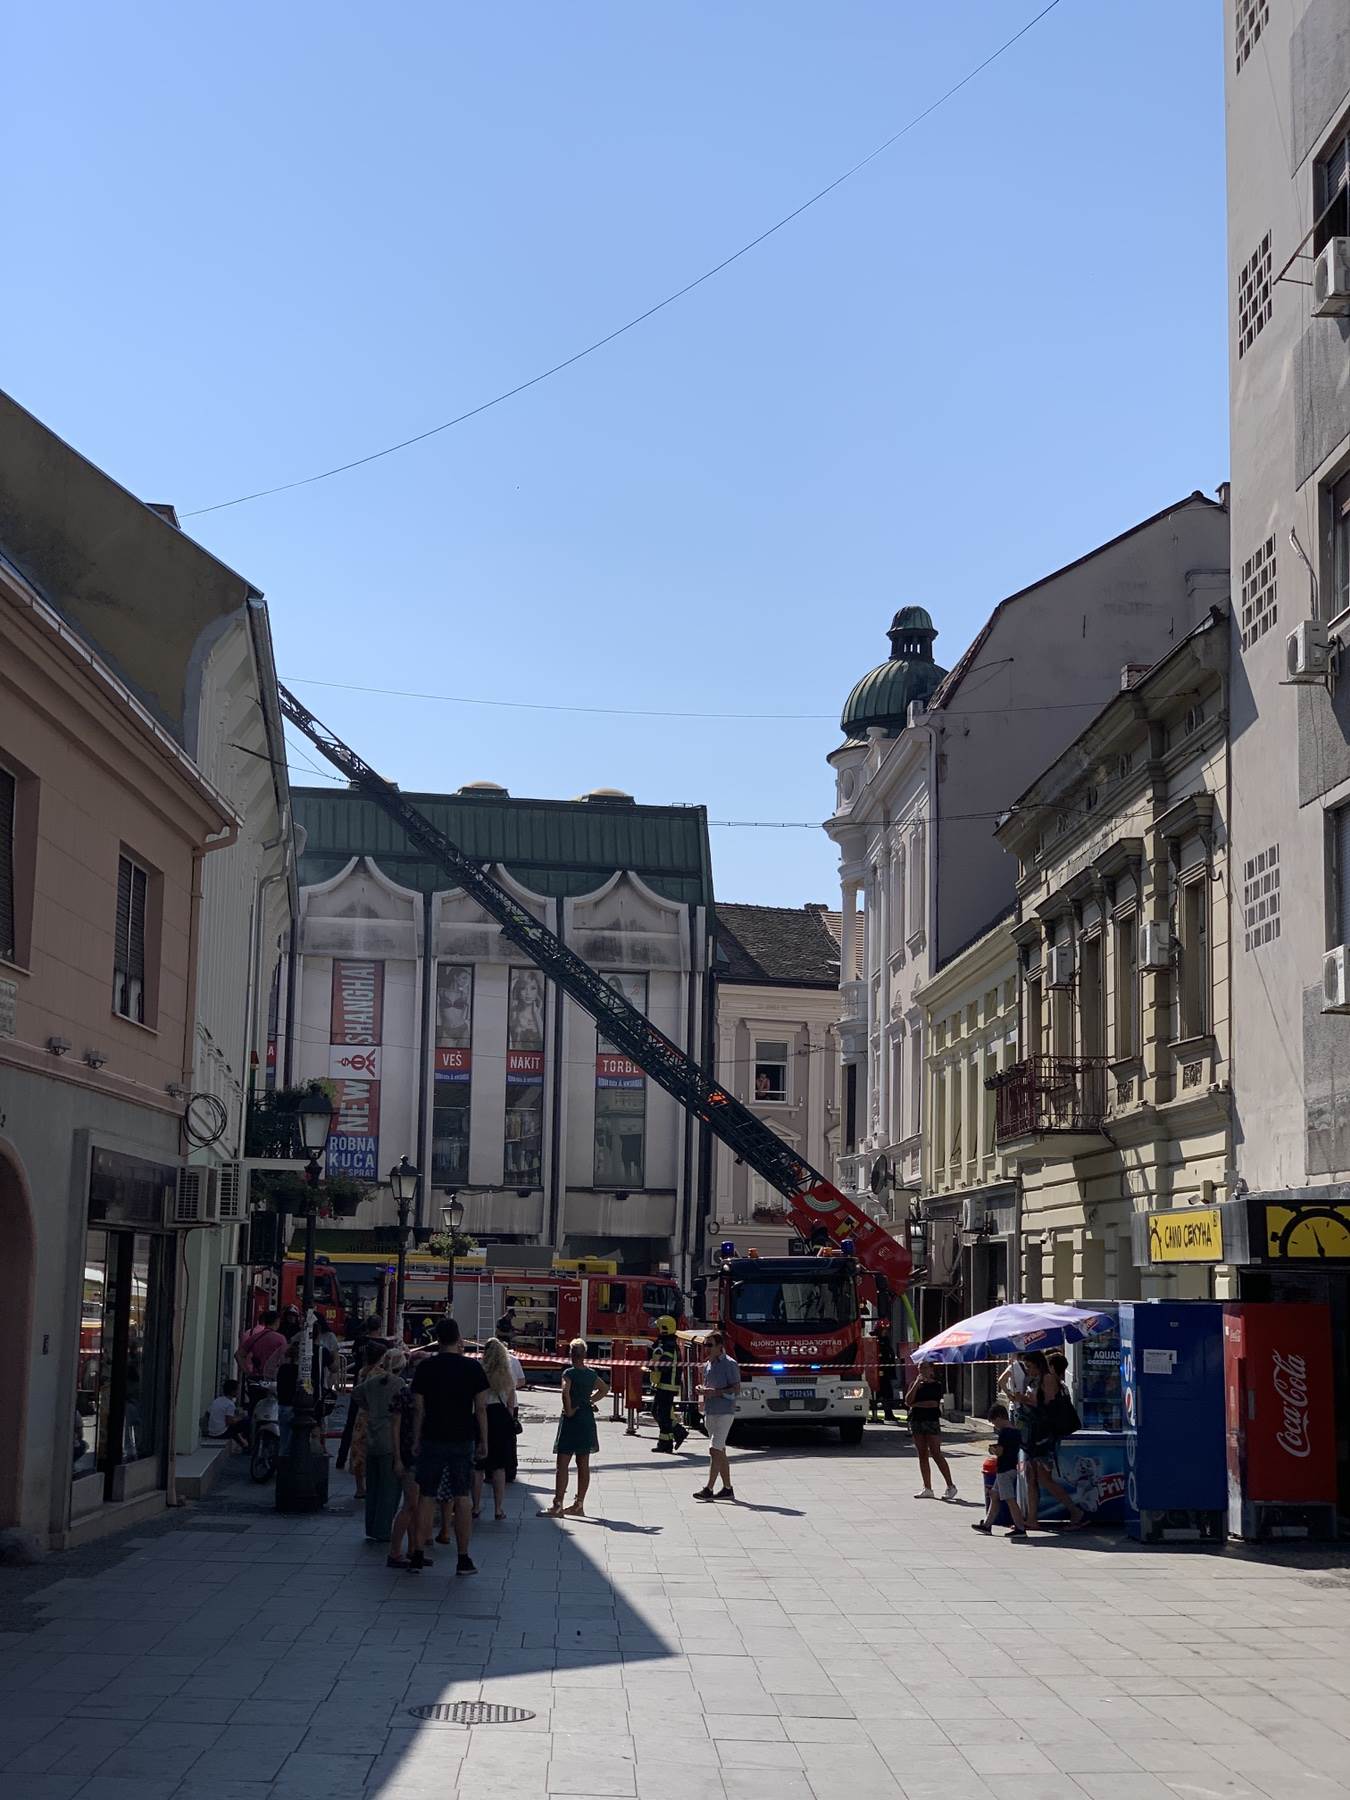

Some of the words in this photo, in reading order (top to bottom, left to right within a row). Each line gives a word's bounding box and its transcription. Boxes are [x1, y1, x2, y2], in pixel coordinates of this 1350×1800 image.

[341, 962, 376, 1045] SHANGHAI
[442, 1050, 462, 1067] VEŠ
[510, 1056, 541, 1070] NAKIT
[337, 1080, 370, 1132] NEW
[329, 1136, 375, 1152] ROBNA
[329, 1151, 375, 1169] KUĆA
[775, 1346, 818, 1355] IVECO
